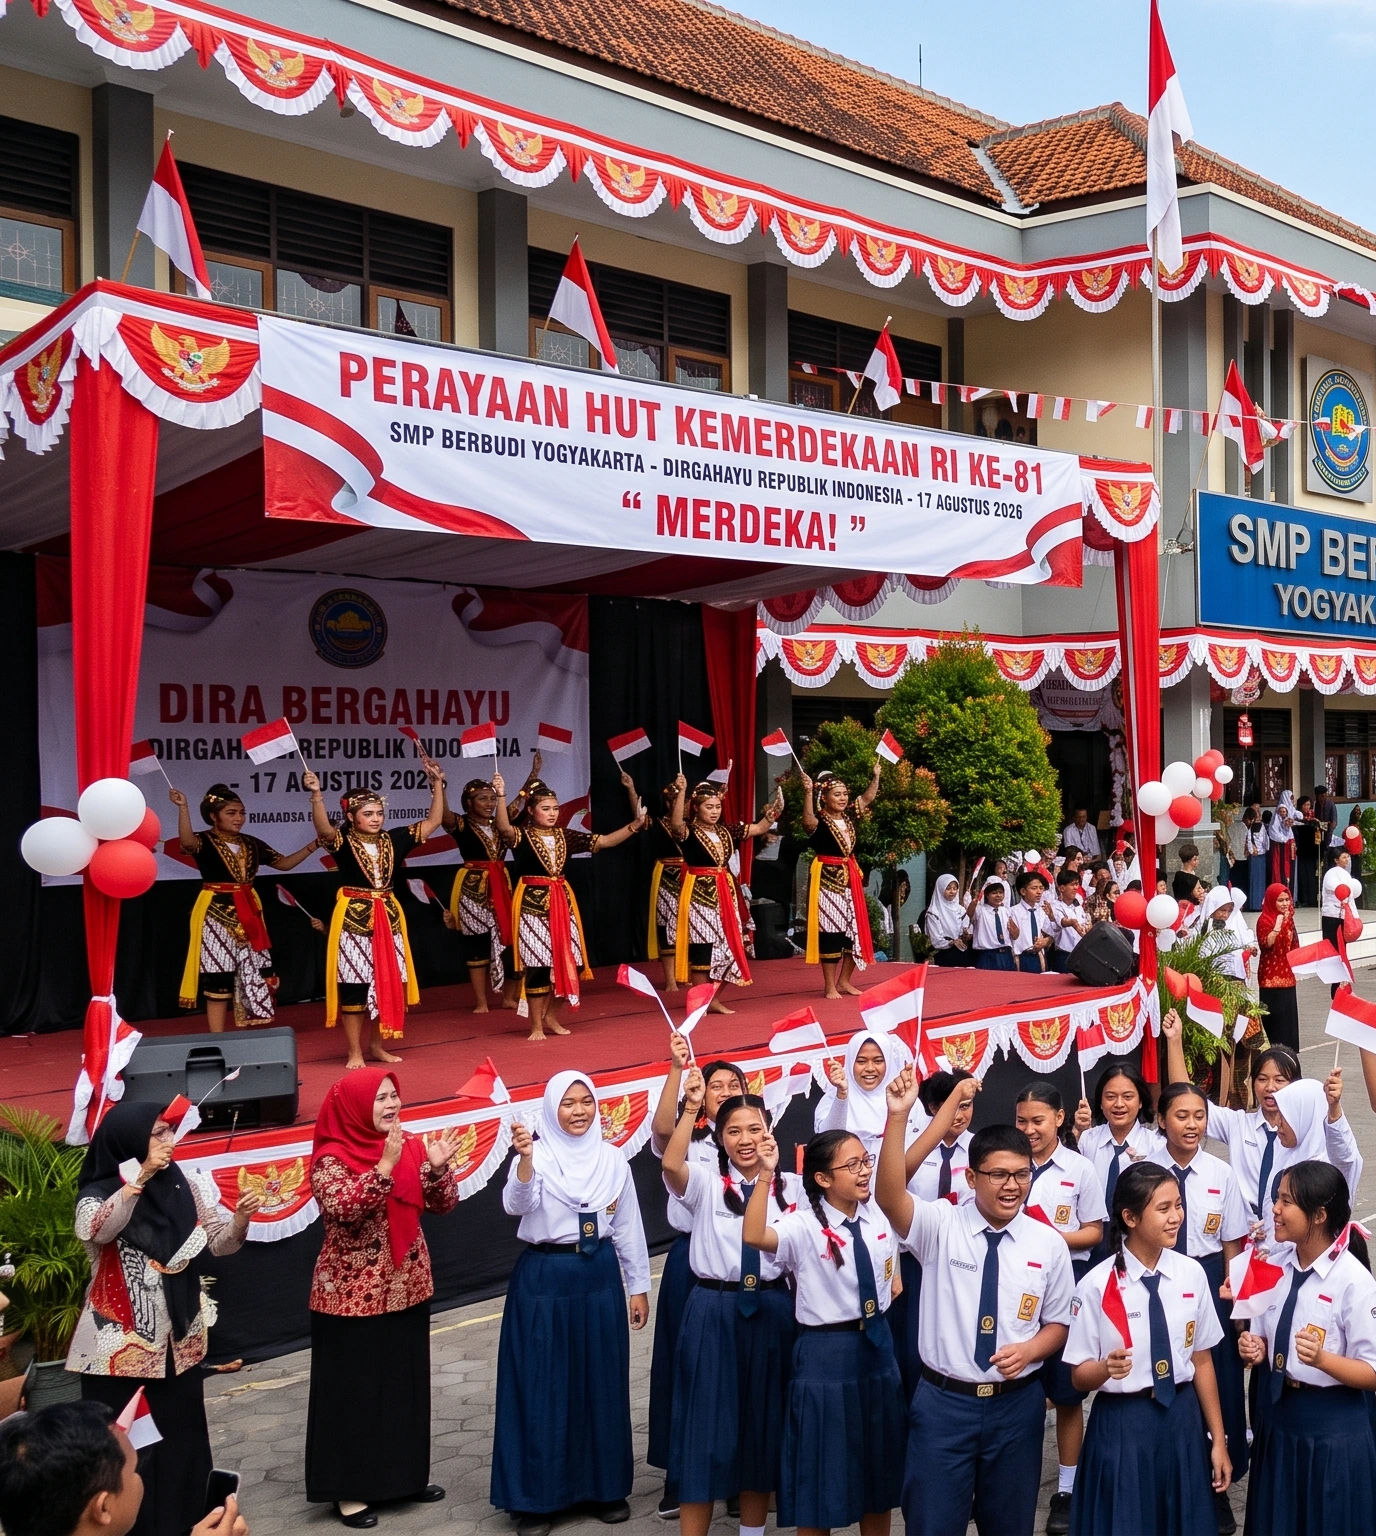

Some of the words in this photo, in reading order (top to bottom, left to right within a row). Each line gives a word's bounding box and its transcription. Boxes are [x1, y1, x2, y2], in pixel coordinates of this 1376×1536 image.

[339, 351, 570, 429] PERAYAAN
[585, 391, 661, 441] HUT
[674, 405, 920, 478] KEMERDEKAAN
[930, 446, 958, 483] RI
[968, 452, 1043, 495] KE-81
[389, 421, 435, 446] SMP
[441, 428, 526, 459] BERBUDI
[531, 440, 645, 473] YOGYAKARTA
[663, 457, 752, 487] DIRGAHAYU
[758, 470, 828, 497] REPUBLIK
[832, 479, 904, 505] INDONESIA
[917, 491, 932, 509] 17
[936, 494, 990, 516] AGUSTUS
[993, 501, 1023, 520] 2026
[656, 494, 837, 551] MERDEKA!
[1228, 513, 1311, 570] SMP
[159, 683, 267, 724] DIRA
[281, 686, 510, 727] BERGAHAYU
[149, 738, 294, 760] DIRGAH
[301, 738, 405, 760] REPUBLIK
[413, 738, 521, 759] INDOIA
[250, 772, 277, 793] 17
[390, 769, 446, 791] 202
